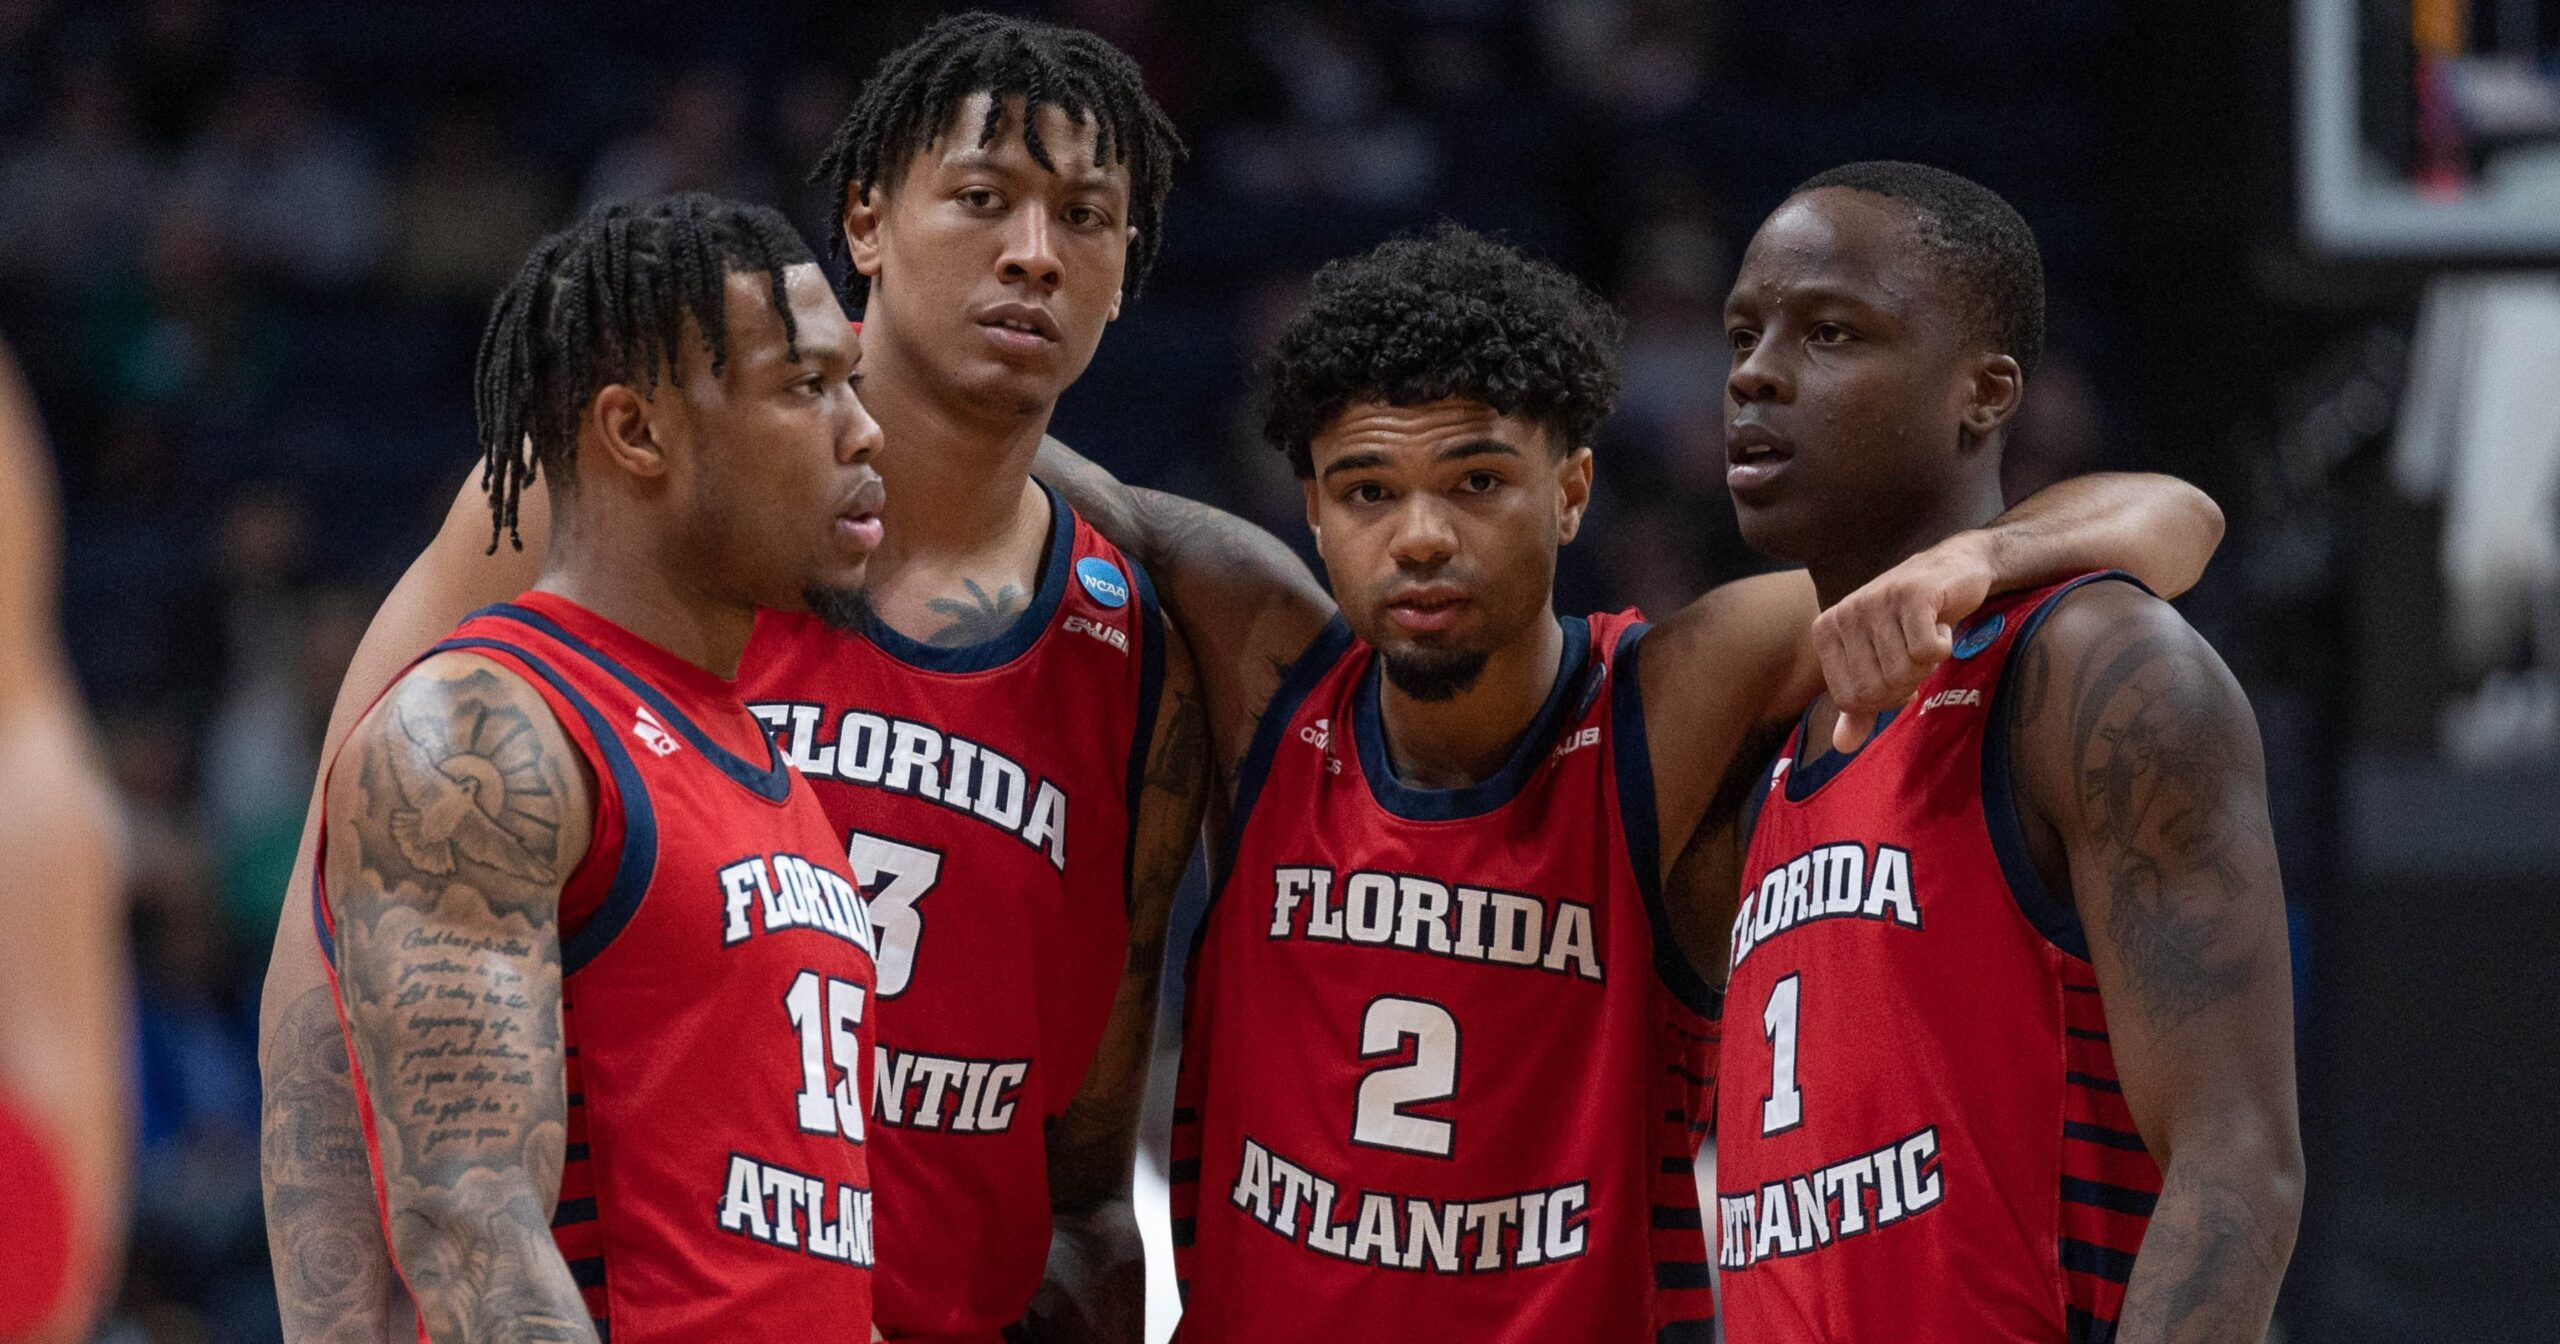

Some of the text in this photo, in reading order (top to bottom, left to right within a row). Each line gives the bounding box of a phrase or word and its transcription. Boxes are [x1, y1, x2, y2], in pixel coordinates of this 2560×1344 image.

[1084, 574, 1126, 600] NCAA
[847, 828, 943, 998] 3
[1268, 865, 1604, 981] FLORIDA
[783, 968, 866, 1144] 15
[1350, 994, 1461, 1160] 2
[1761, 971, 1803, 1138] 1
[1231, 1136, 1589, 1275] ATLANTIC
